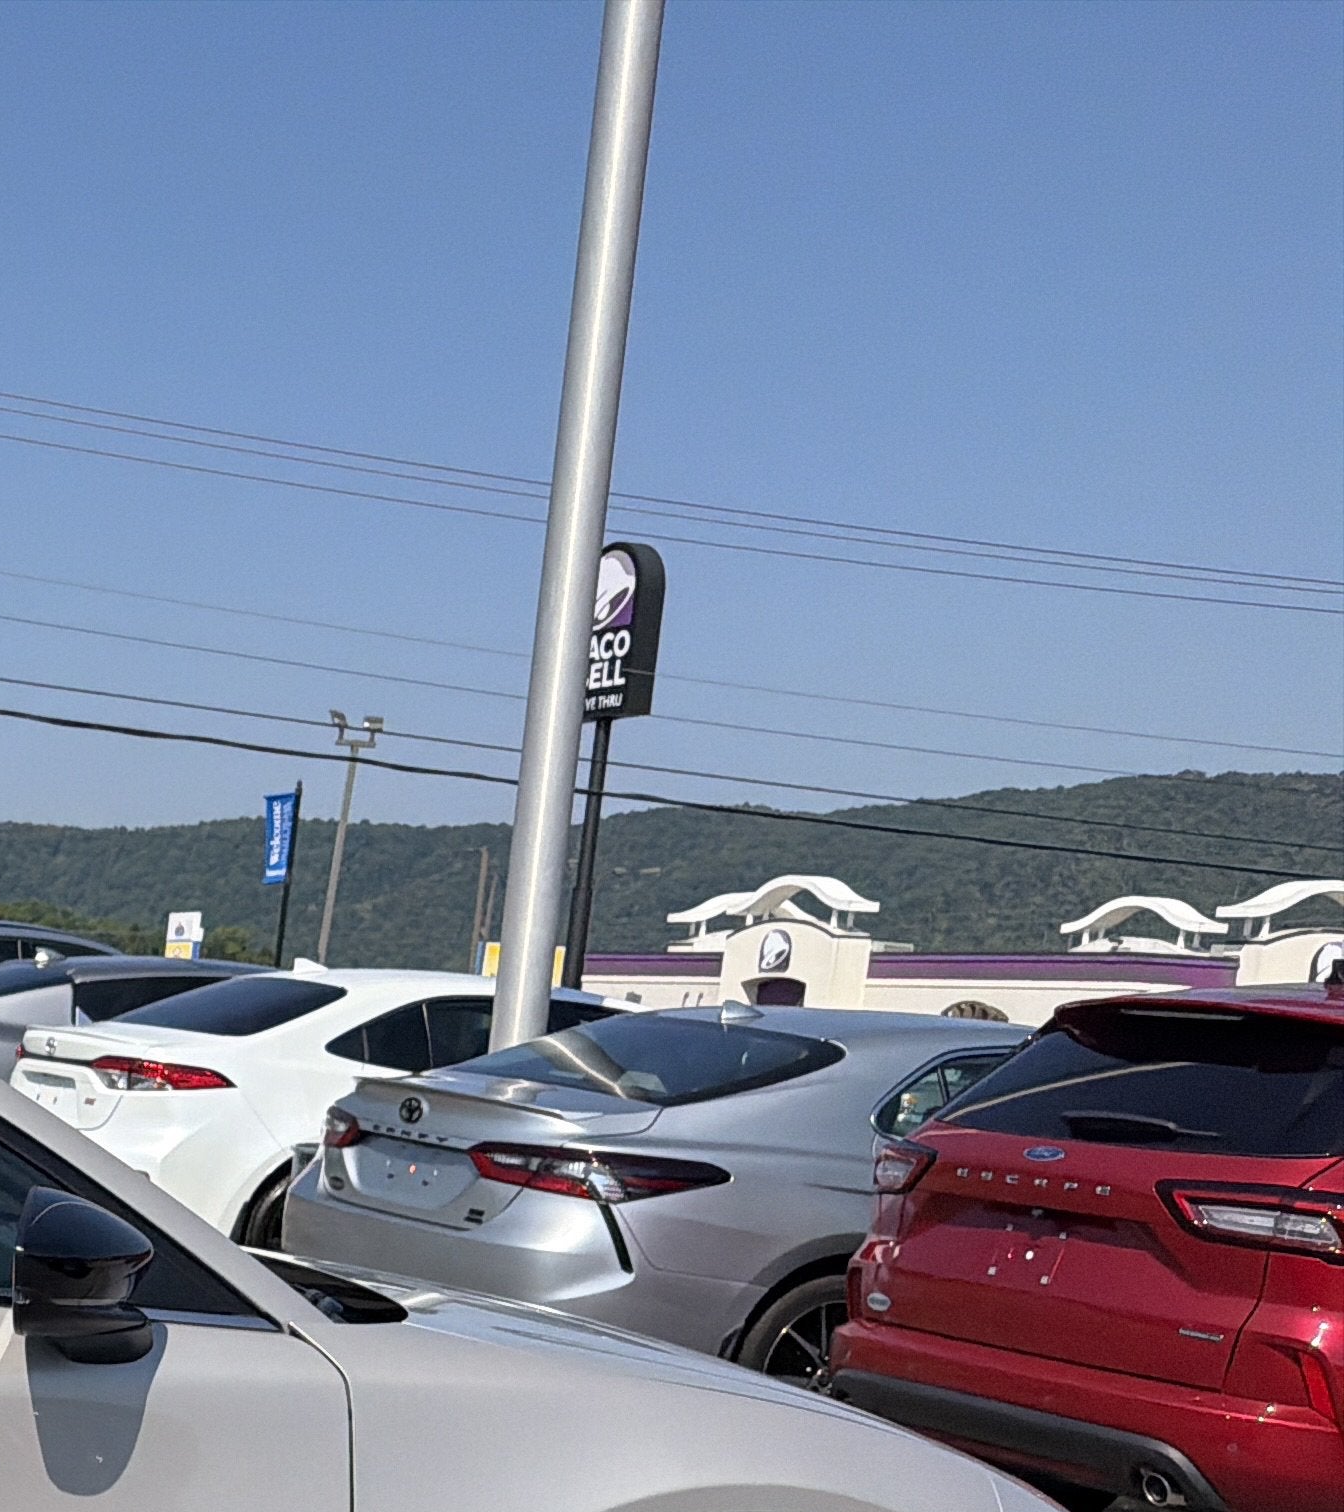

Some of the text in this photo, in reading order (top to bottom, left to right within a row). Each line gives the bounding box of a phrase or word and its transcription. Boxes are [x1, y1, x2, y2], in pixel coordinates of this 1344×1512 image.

[589, 629, 631, 661] ACO
[585, 659, 626, 691] ELL
[598, 692, 624, 710] THRU
[956, 1167, 1112, 1197] ESCAPE
